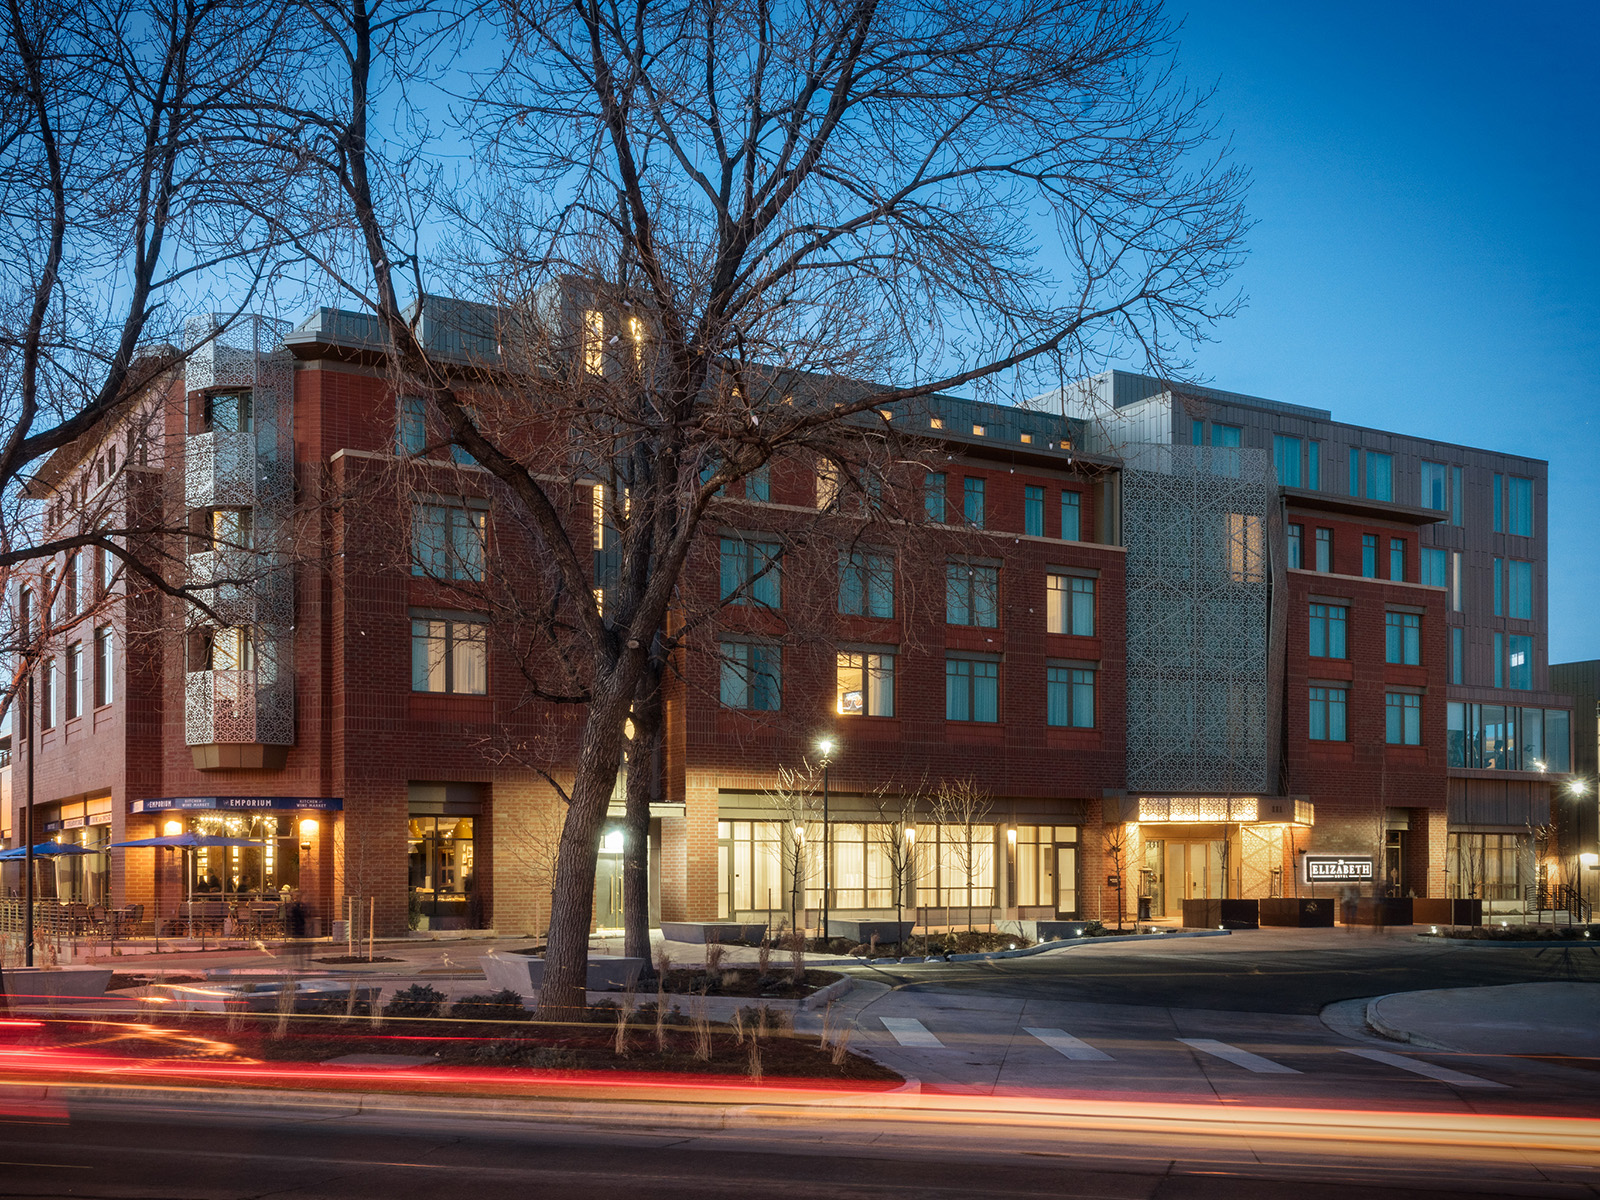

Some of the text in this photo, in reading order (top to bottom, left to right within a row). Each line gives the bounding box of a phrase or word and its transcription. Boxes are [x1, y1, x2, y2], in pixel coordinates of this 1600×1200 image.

[149, 800, 172, 808] EMPORIUM
[230, 799, 272, 807] EMPORIUM
[1312, 864, 1370, 874] ELIZABETH
